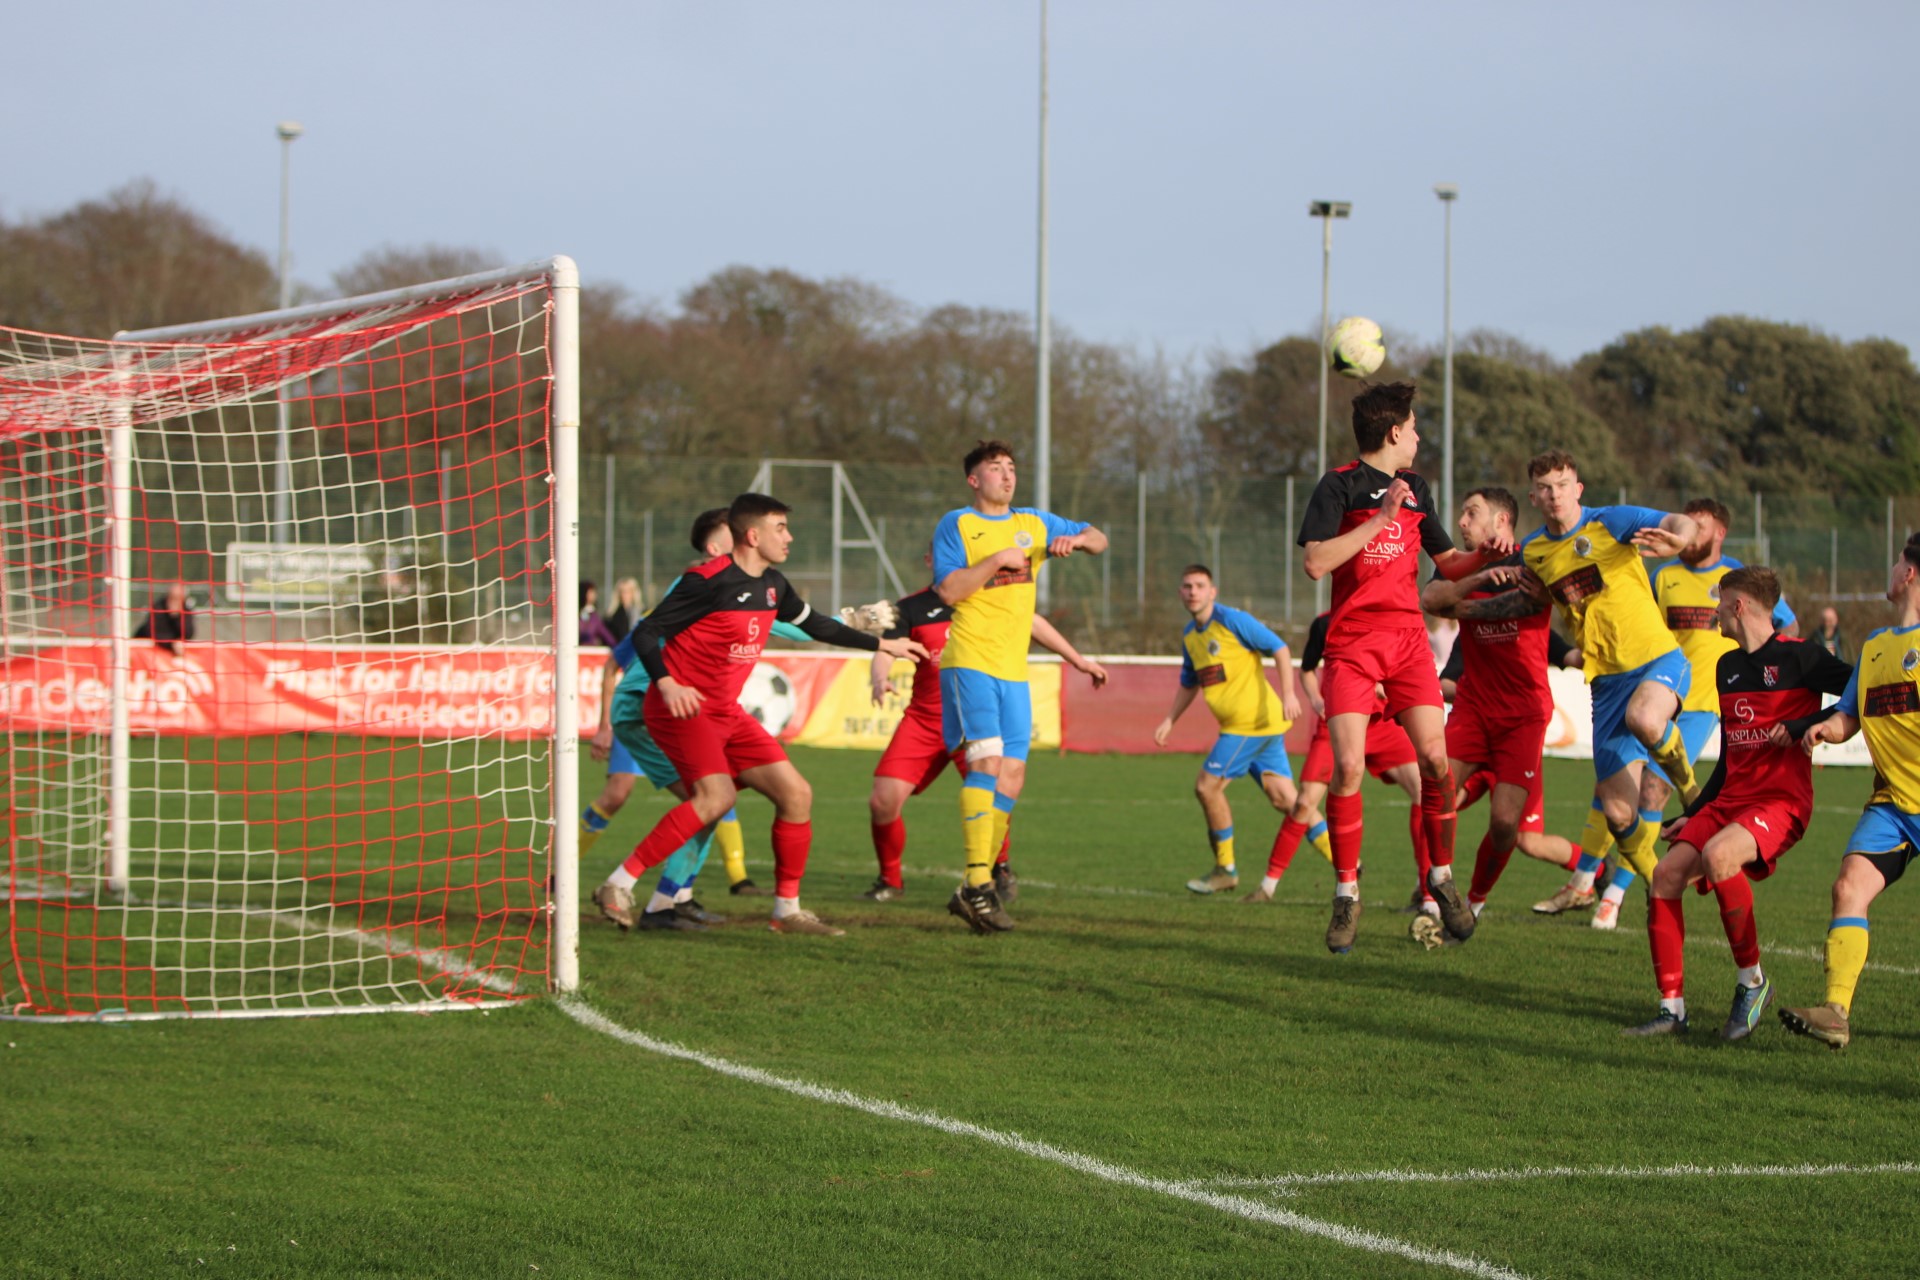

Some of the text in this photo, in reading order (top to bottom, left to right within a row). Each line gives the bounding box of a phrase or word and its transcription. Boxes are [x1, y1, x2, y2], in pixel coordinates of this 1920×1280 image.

[1473, 621, 1518, 635] ASPIAN
[349, 663, 404, 692] for
[406, 662, 517, 694] Island
